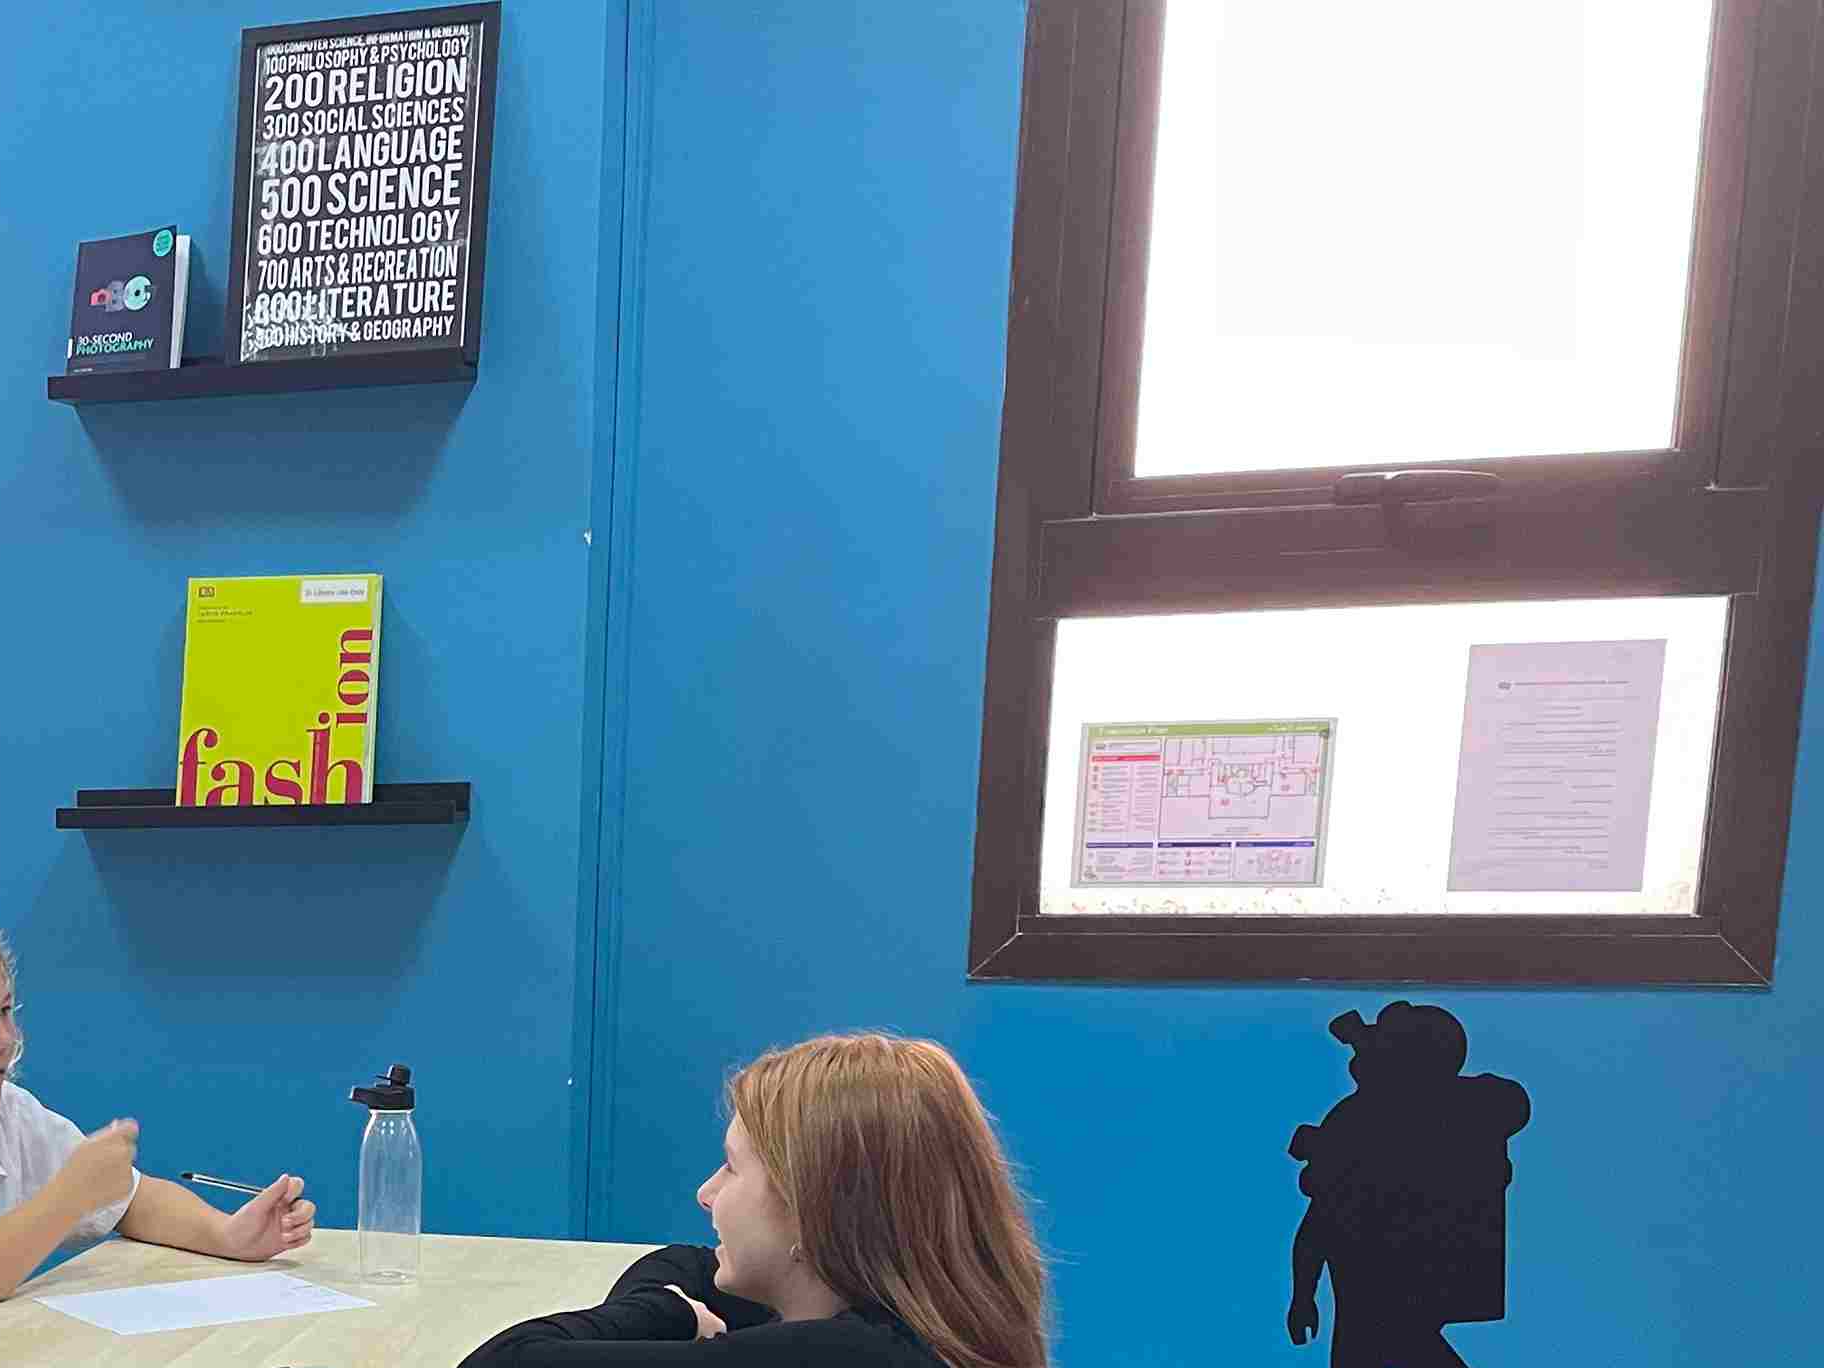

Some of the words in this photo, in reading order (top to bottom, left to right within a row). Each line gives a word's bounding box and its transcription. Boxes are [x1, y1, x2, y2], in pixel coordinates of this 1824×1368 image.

[266, 55, 287, 75] 100
[288, 47, 368, 73] PHILOSOPHY
[369, 46, 380, 64] &
[381, 36, 469, 63] PSYCHOLOGY
[264, 71, 324, 111] 200
[328, 56, 467, 105] RELIGION
[263, 112, 299, 140] 300
[302, 106, 368, 135] SOCIAL
[371, 97, 464, 129] SCIENCES
[261, 138, 314, 176] 400
[317, 124, 464, 172] LANGUAGE
[261, 174, 321, 220] 500
[326, 162, 463, 215] SCIENCE
[258, 222, 302, 255] 600
[307, 209, 460, 250] TECHNOLOGY
[258, 258, 288, 291] 700
[290, 254, 335, 288] ARTS
[337, 252, 349, 284] &
[351, 245, 458, 283] RECREATION
[303, 279, 457, 321] LITERATURE
[76, 338, 154, 355] PHOTOGRAPHY
[284, 320, 349, 347] HISTORY
[351, 321, 361, 341] &
[363, 315, 454, 341] GEOGRAPHY
